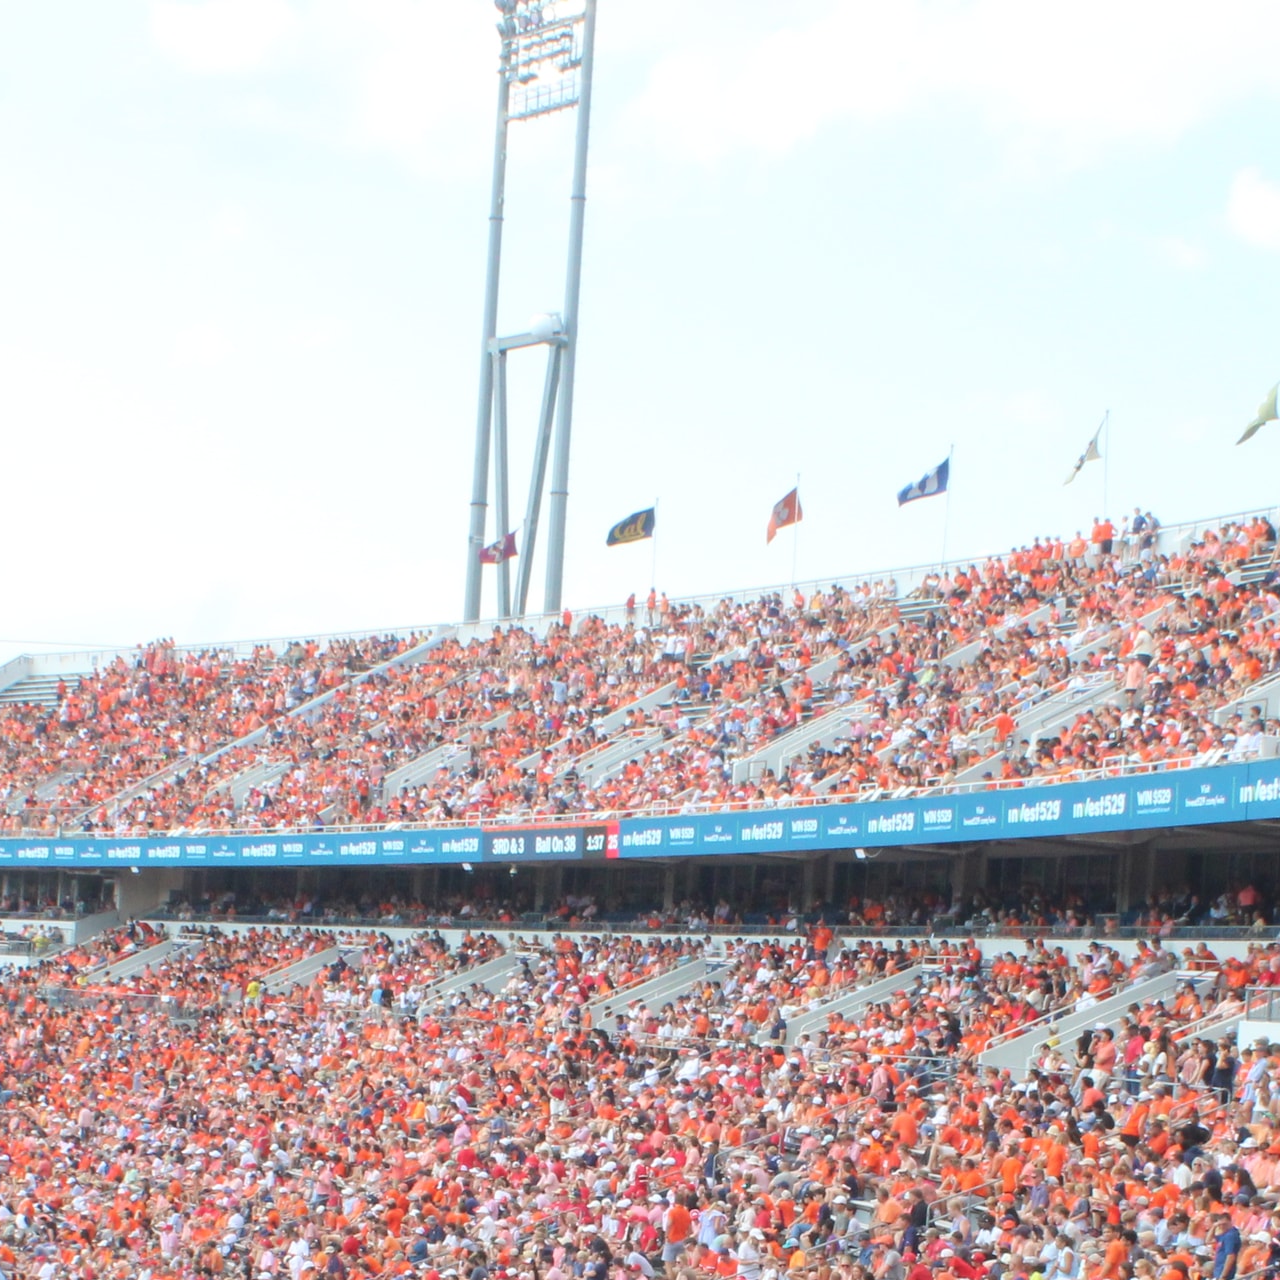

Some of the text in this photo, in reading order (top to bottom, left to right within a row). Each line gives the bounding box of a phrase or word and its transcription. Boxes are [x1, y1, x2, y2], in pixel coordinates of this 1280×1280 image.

[1073, 792, 1126, 818] invest529
[1137, 790, 1153, 806] WIN
[1008, 799, 1061, 823] invest529
[868, 812, 914, 833] invest529
[492, 837, 524, 854] 3RD & 3
[535, 835, 576, 854] Ball On 38
[587, 835, 604, 850] 1:37
[608, 835, 618, 849] 25
